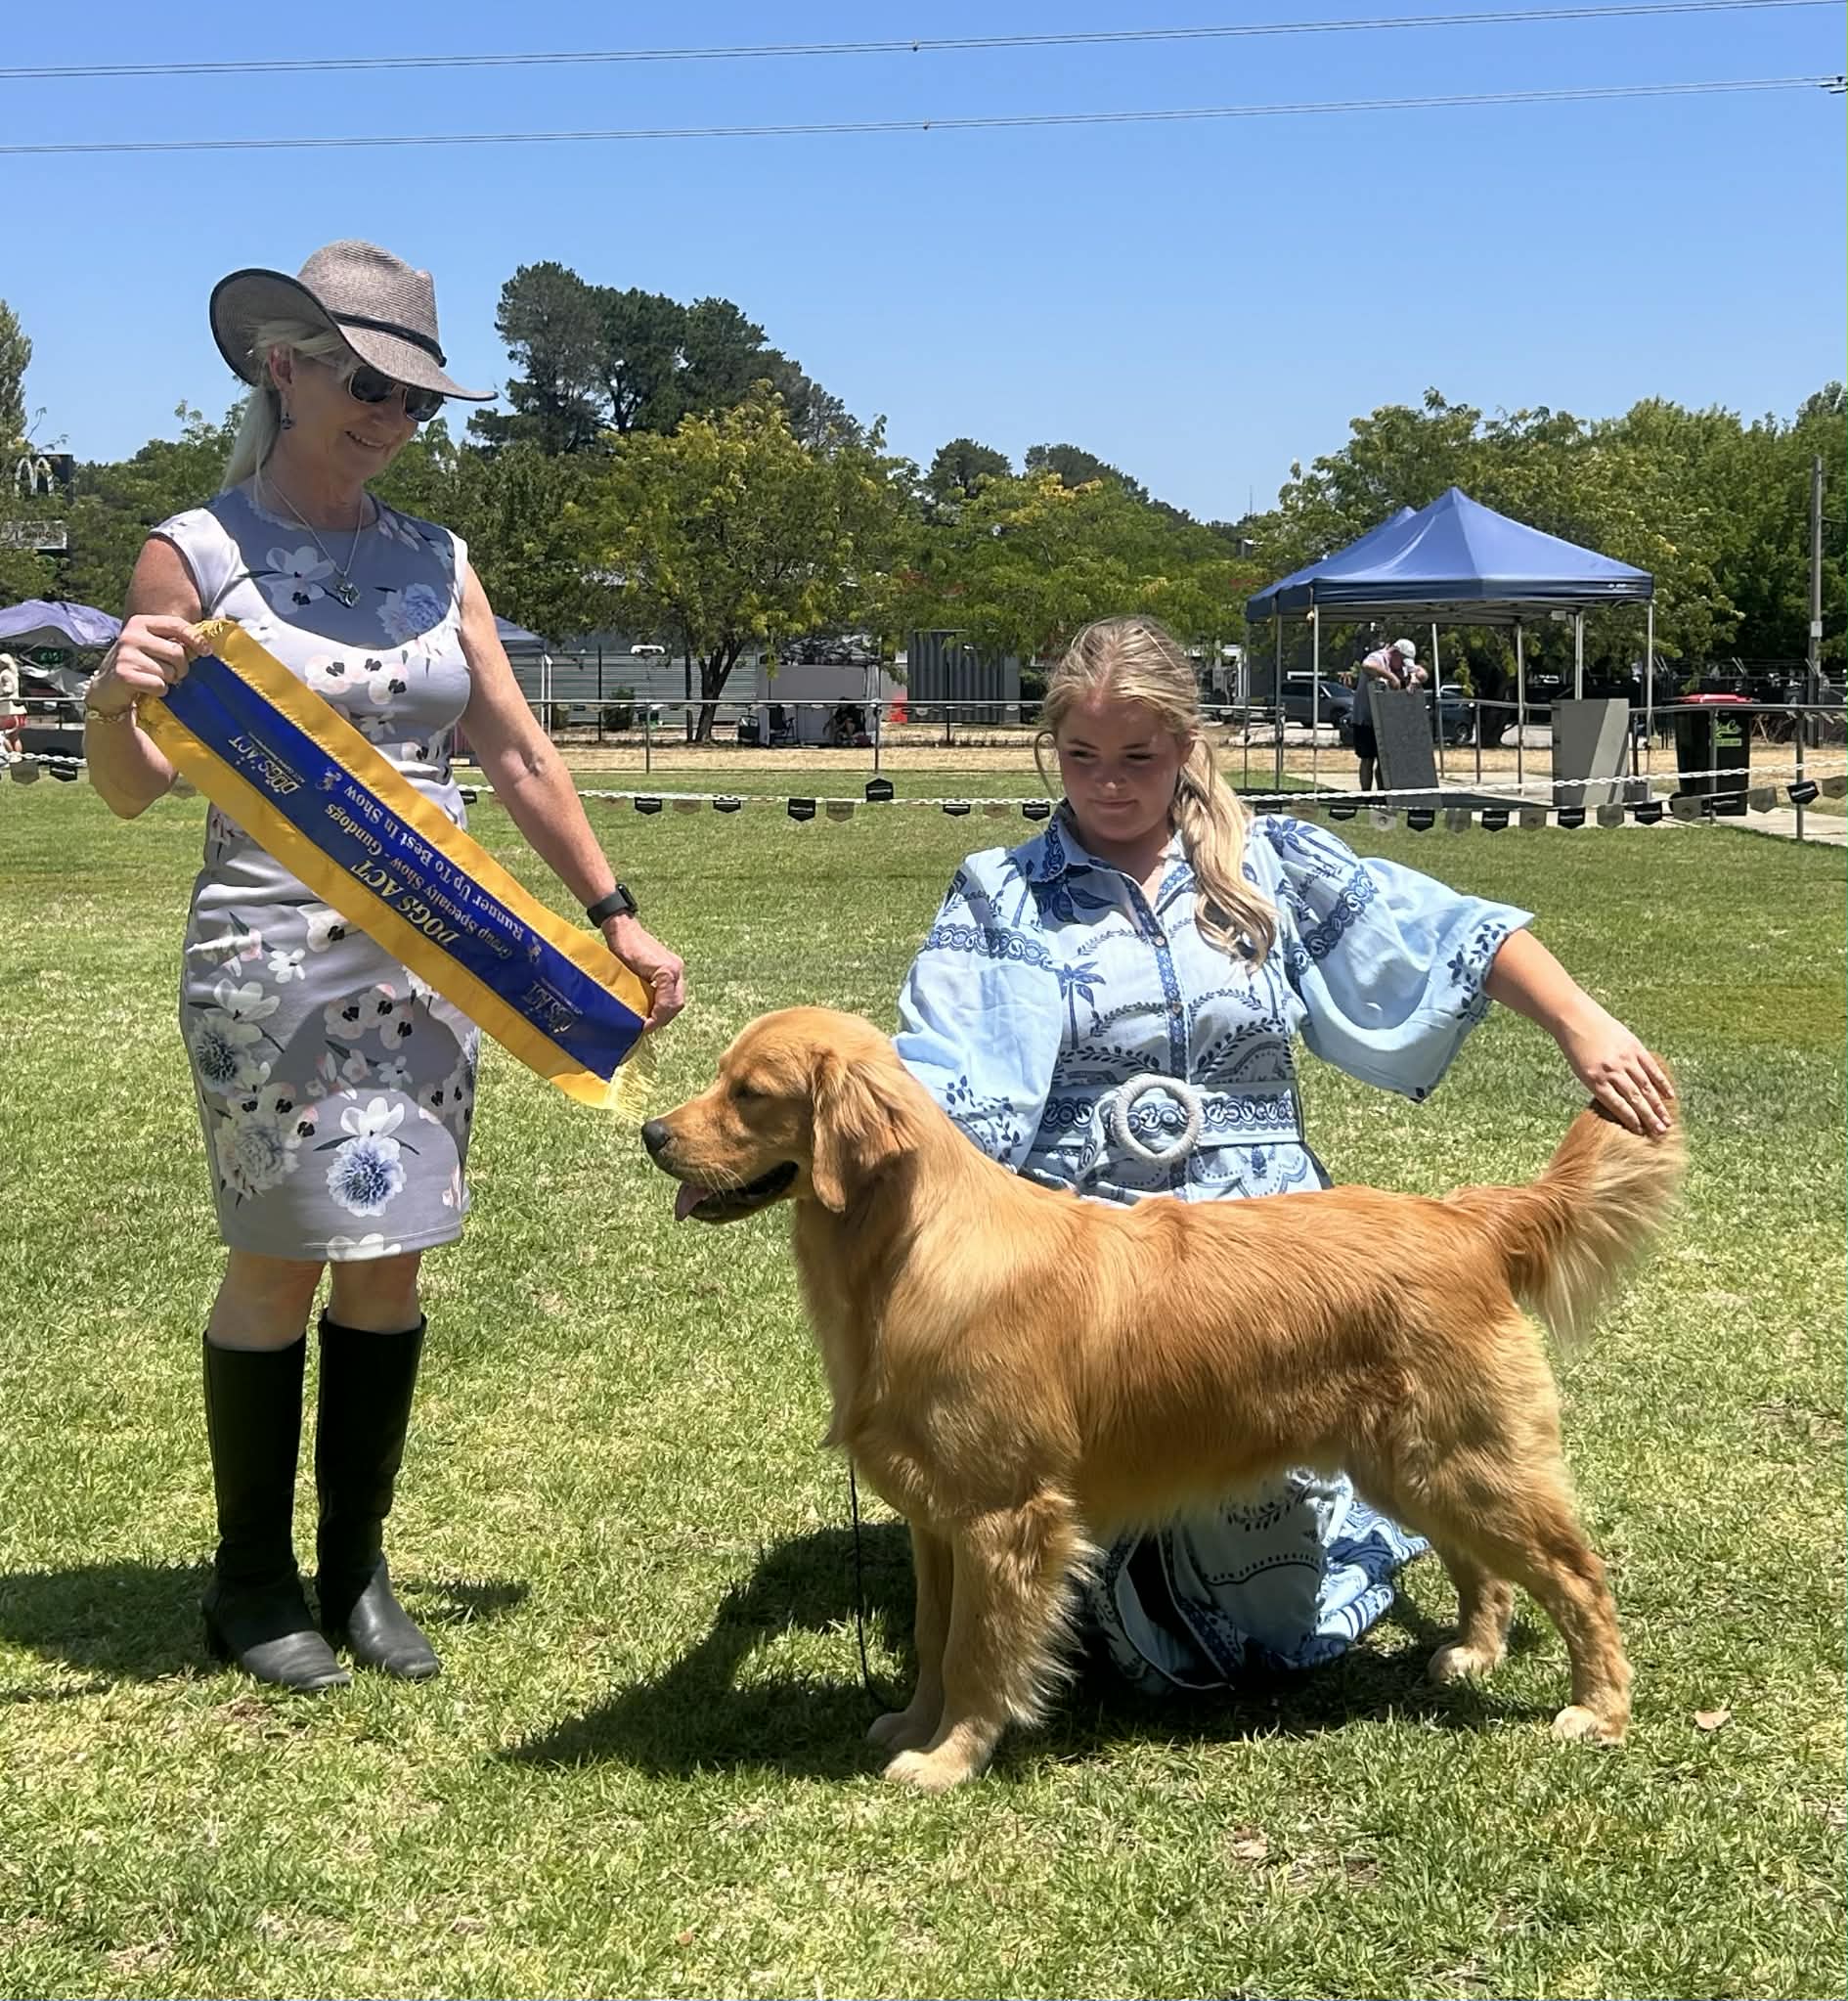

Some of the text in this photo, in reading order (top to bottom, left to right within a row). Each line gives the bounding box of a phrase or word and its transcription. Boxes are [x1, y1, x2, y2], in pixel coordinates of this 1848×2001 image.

[226, 734, 261, 758] ACT
[254, 757, 301, 794] DOGS
[322, 801, 385, 858] Gundogs
[340, 783, 523, 942] Runner Up To Best In Show
[386, 854, 426, 891] Show
[349, 858, 460, 946] DOGS ACT
[420, 882, 480, 936] Specialty
[474, 923, 512, 961] Group
